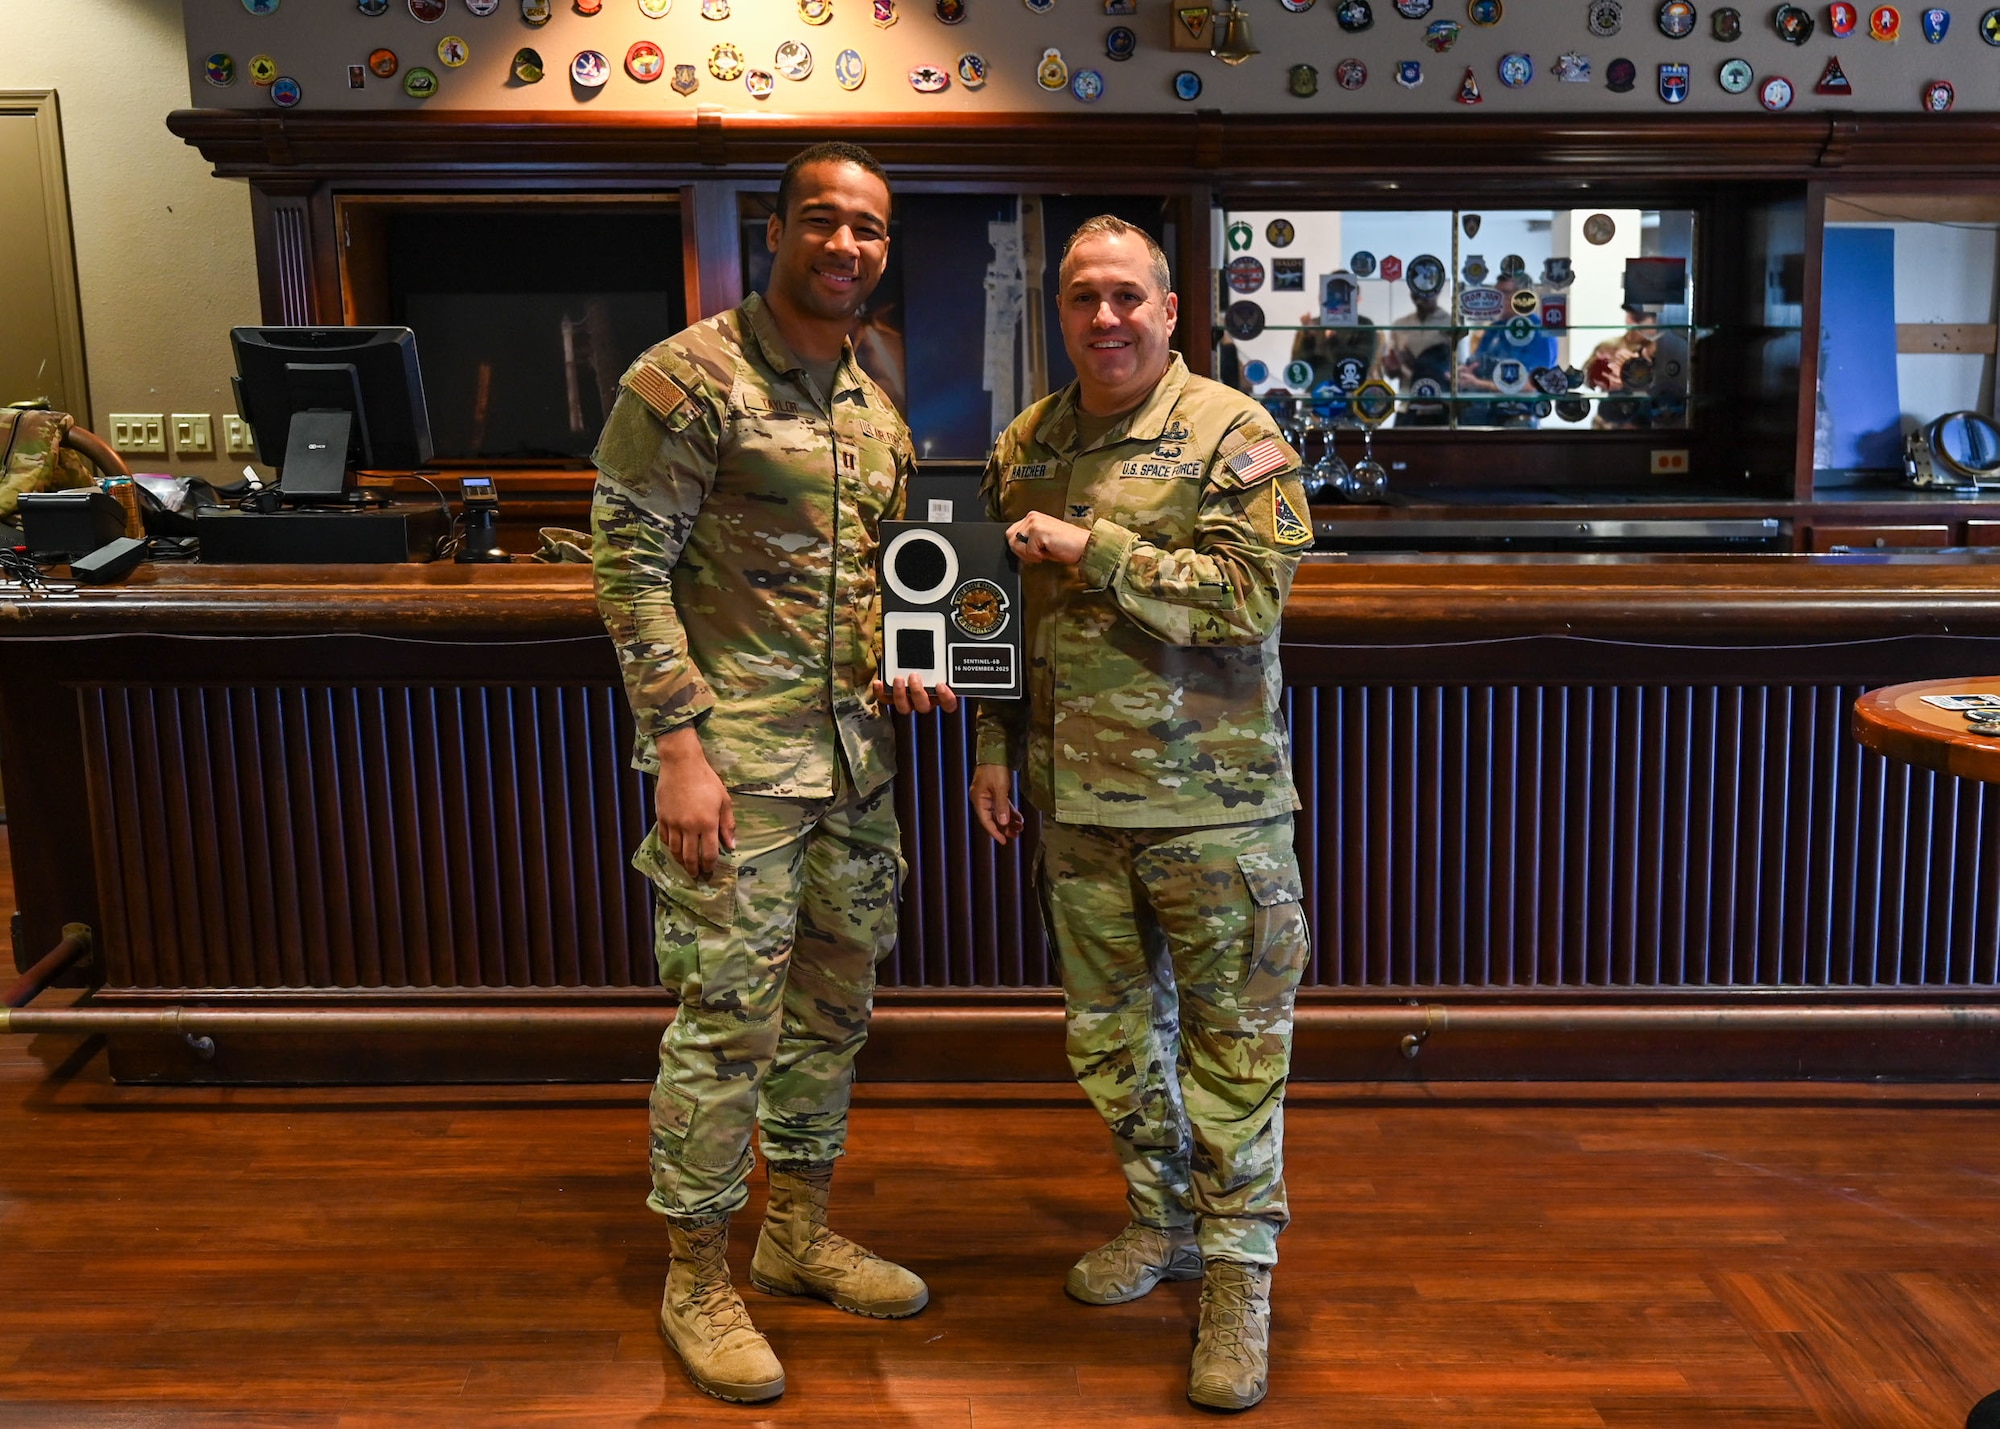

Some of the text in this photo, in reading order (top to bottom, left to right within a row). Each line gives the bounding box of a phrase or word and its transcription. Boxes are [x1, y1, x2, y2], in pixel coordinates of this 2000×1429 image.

[760, 396, 799, 414] TAYLOR
[875, 427, 886, 441] AIR
[1122, 462, 1200, 477] U.S. SPACE FORCE
